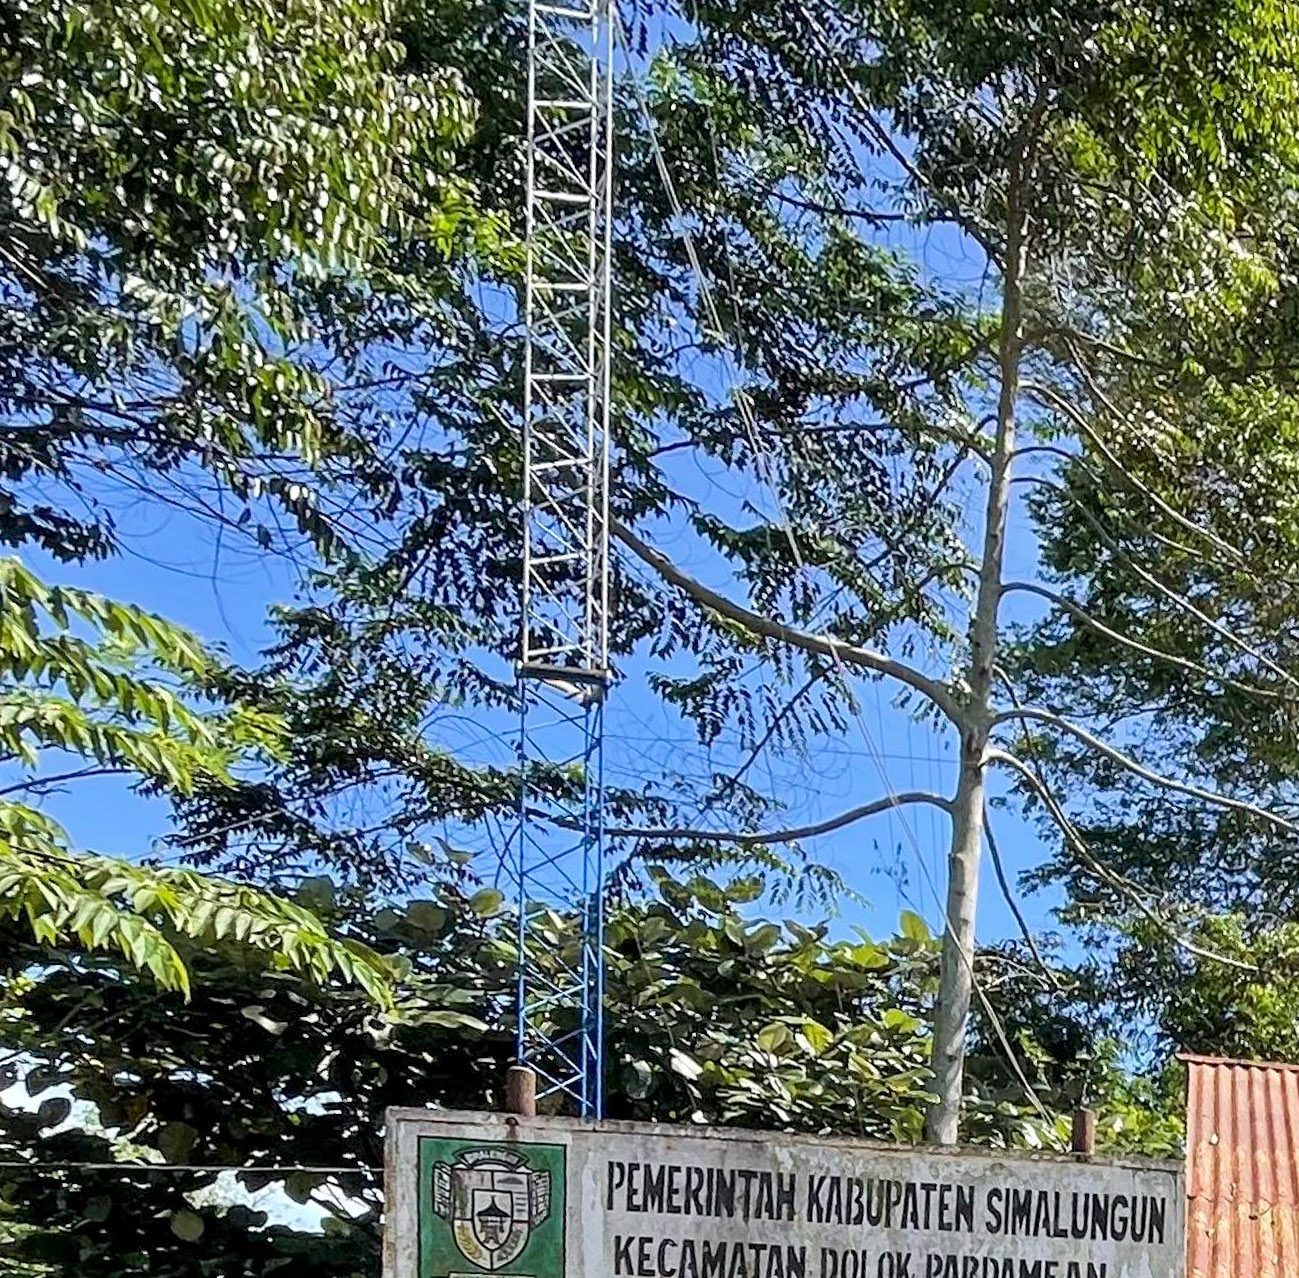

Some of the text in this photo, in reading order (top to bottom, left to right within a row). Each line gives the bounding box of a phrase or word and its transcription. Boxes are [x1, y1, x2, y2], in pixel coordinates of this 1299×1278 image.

[607, 1161, 796, 1222] PEMERINTAH
[807, 1174, 974, 1232] KABUPATEN
[985, 1188, 1165, 1243] SIMALUNGUN
